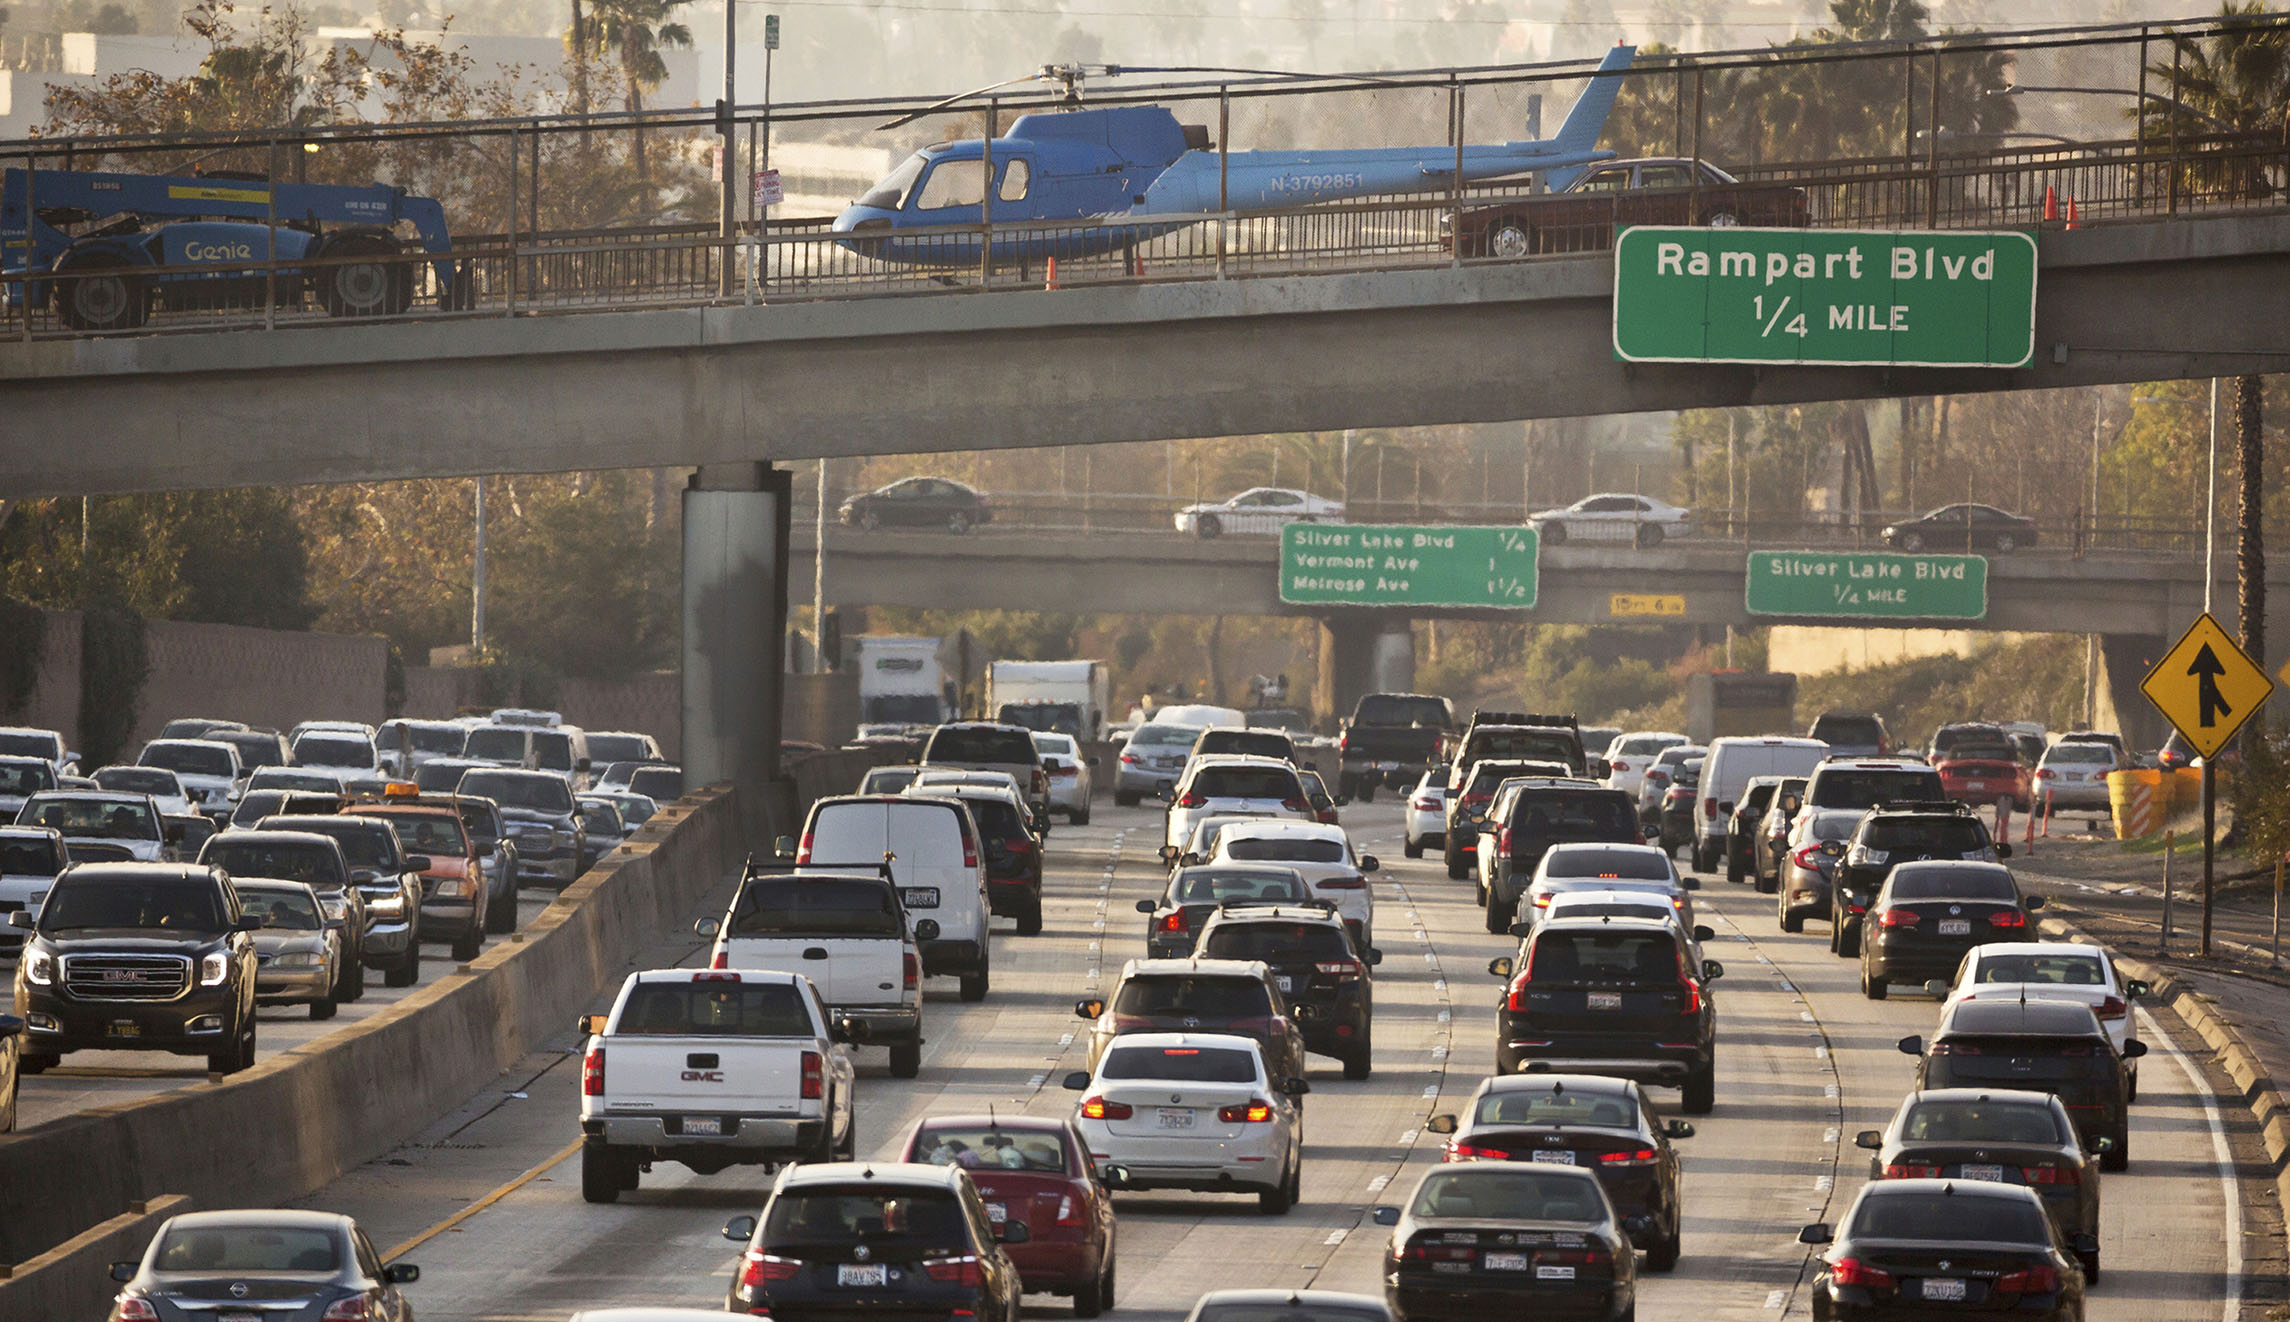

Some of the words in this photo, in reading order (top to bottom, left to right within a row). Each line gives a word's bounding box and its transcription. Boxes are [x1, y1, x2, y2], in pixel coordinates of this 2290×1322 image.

[1271, 172, 1363, 192] N-3792851
[184, 240, 252, 262] Genie
[1657, 242, 1863, 287] Rampart
[1890, 246, 1995, 281] Blvd
[1753, 295, 1809, 338] 1/4
[1828, 304, 1909, 331] MILE
[1295, 530, 1351, 546] Silver
[1360, 533, 1404, 548] Lake
[1412, 533, 1455, 549] Blvd
[1499, 531, 1527, 552] 1/4
[1296, 553, 1375, 569] Vermont
[1384, 556, 1420, 572] Ave
[1771, 558, 1839, 577] Silver
[1848, 560, 1902, 579] Lake
[1914, 561, 1966, 580] Blvd
[1293, 575, 1366, 592] Melrose
[1376, 577, 1410, 591] Ave
[1834, 583, 1860, 605] 1/4
[1867, 588, 1908, 603] MILE
[104, 970, 148, 982] GMC
[681, 1071, 725, 1083] GMC
